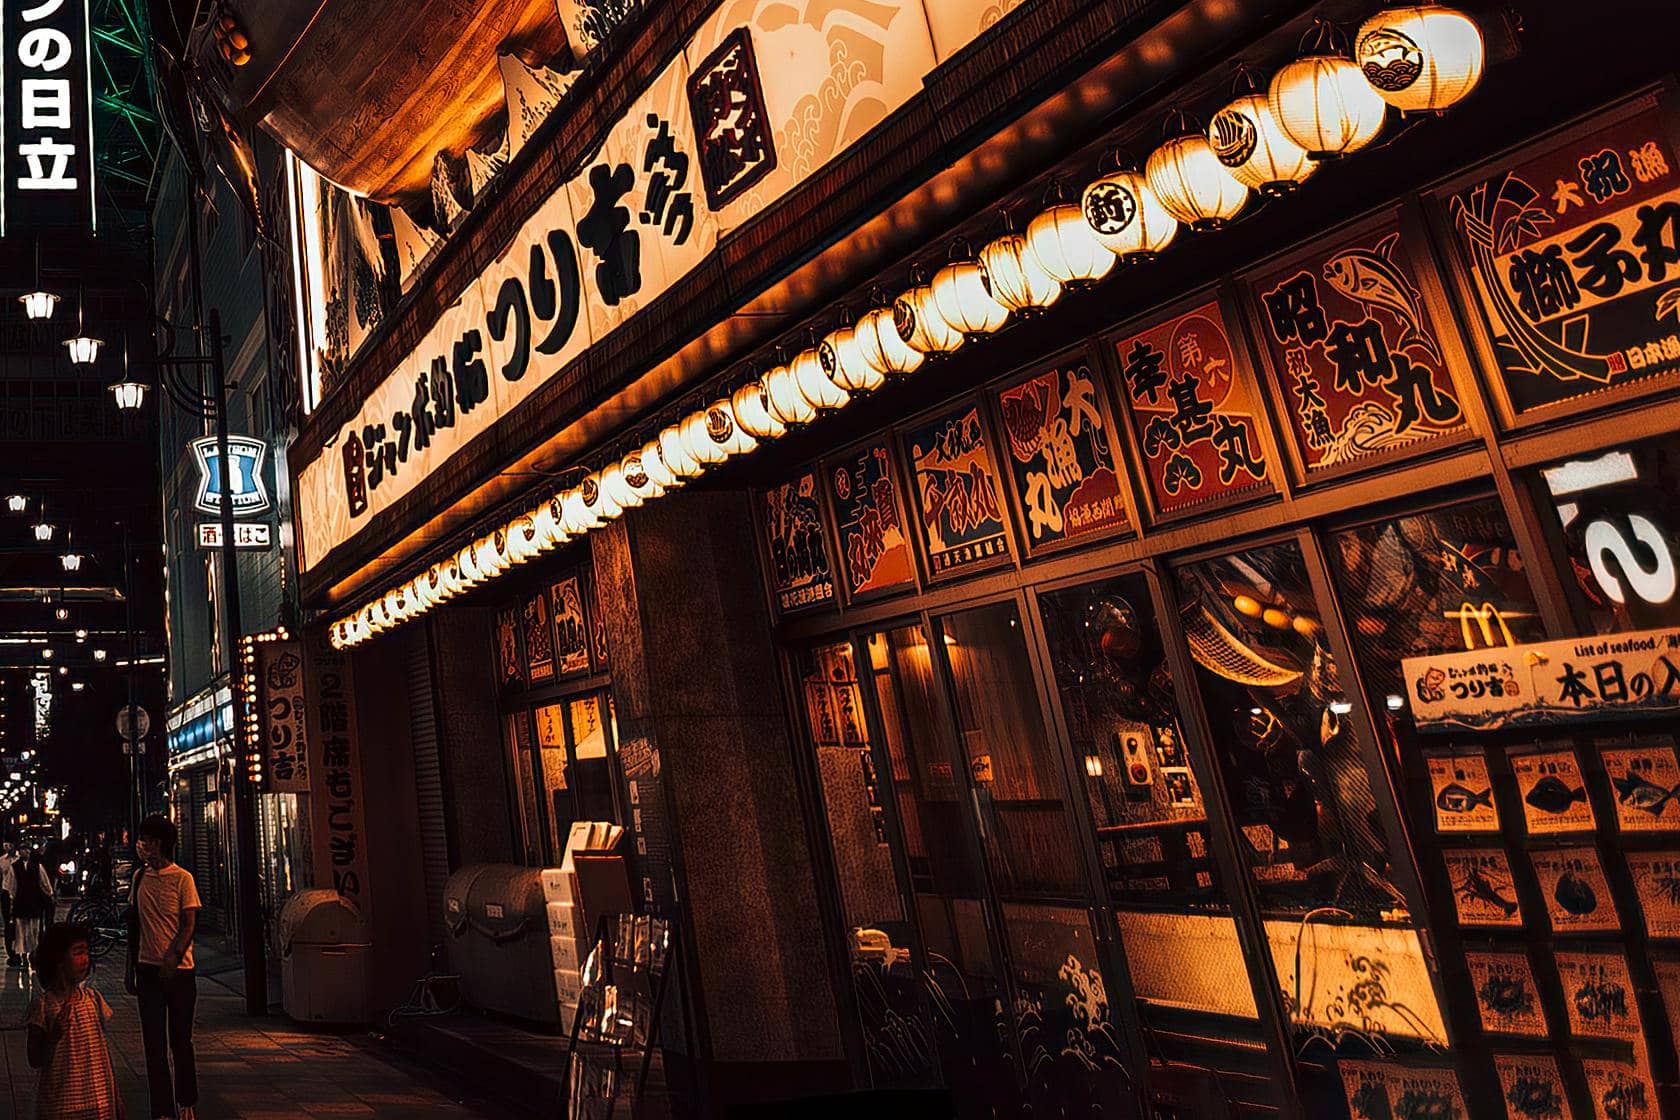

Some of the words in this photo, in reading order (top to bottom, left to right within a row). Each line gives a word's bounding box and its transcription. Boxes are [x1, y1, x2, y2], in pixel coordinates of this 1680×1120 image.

[1177, 332, 1231, 388] 第六
[1262, 270, 1460, 436] 昭和丸
[202, 443, 258, 458] LASON
[205, 490, 262, 506] STTION
[1574, 644, 1595, 657] List
[1597, 642, 1608, 655] of
[1449, 677, 1504, 700] つり吉
[270, 695, 297, 781] つり吉
